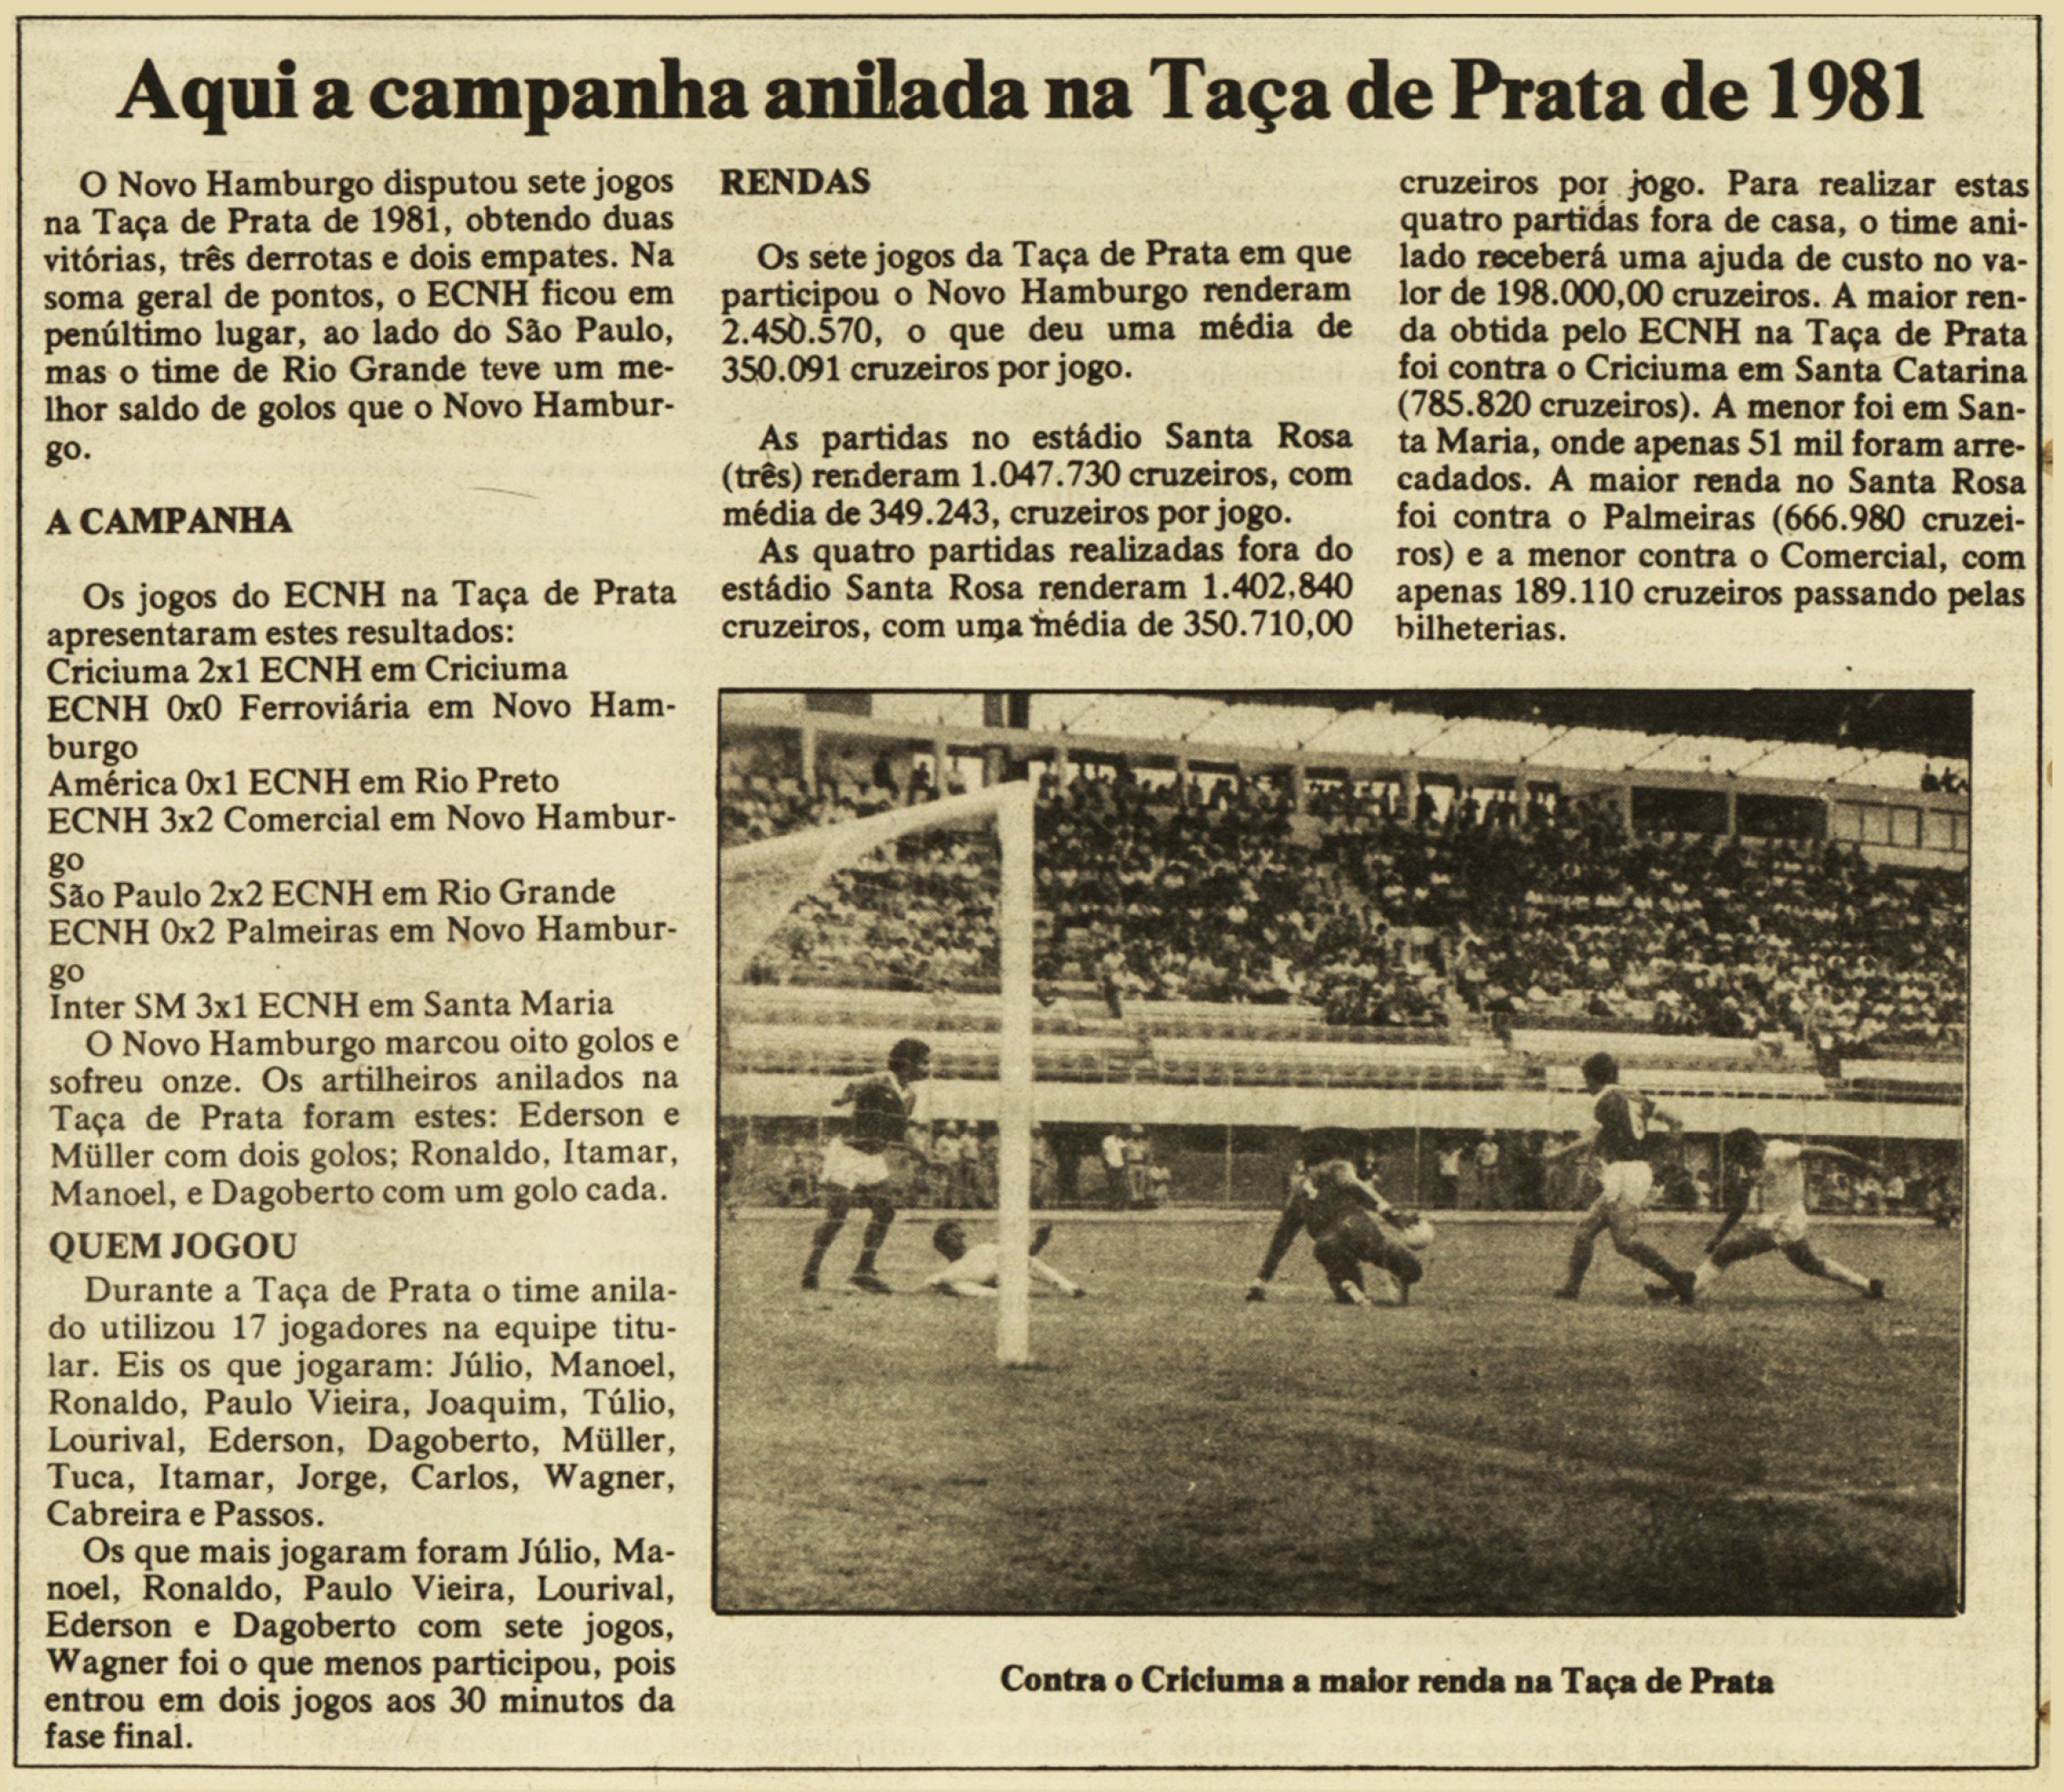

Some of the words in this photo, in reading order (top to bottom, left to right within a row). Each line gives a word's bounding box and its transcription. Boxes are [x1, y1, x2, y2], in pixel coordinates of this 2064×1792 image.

[115, 58, 299, 136] Aqui
[312, 78, 354, 120] a
[368, 57, 749, 137] campanha
[764, 57, 1029, 120] anilada
[1043, 77, 1133, 120] na
[1149, 57, 1332, 134] Taça
[1346, 58, 1434, 120] de
[1450, 58, 1645, 122] Prata
[1660, 58, 1749, 121] de
[1768, 57, 1925, 122] 1981
[79, 170, 107, 198] O
[118, 170, 197, 198] Novo
[206, 169, 374, 204] Hamburgo
[383, 168, 518, 203] disputou
[528, 170, 586, 195] sete
[592, 167, 673, 202] jogos
[720, 167, 871, 196] RENDAS
[1399, 168, 1539, 195] cruzeiros
[1559, 175, 1609, 203] por
[1627, 168, 1705, 203] jogo.
[1727, 168, 1799, 196] Para
[1819, 169, 1937, 197] realizar
[1955, 174, 2030, 198] estas
[1399, 242, 1466, 270] lado
[1477, 241, 1608, 270] receberá
[1618, 250, 1687, 270] uma
[1698, 243, 1785, 278] ajuda
[1796, 243, 1831, 271] de
[1842, 247, 1924, 272] custo
[1933, 252, 1972, 273] no
[1982, 252, 2028, 273] va-
[44, 318, 202, 356] penúltimo
[215, 319, 306, 354] lugar,
[323, 325, 359, 345] ao
[372, 317, 440, 345] lado
[453, 317, 491, 345] do
[506, 316, 562, 344] São
[576, 315, 673, 346] Paulo,
[721, 317, 883, 347] 2.450.570,
[907, 324, 926, 344] o
[949, 323, 1005, 351] que
[1028, 314, 1084, 342] deu
[1107, 320, 1176, 341] uma
[1199, 311, 1295, 340] média
[1316, 311, 1353, 339] de
[721, 354, 840, 384] 350.091
[850, 353, 989, 381] cruzeiros
[997, 360, 1051, 387] por
[1055, 352, 1132, 387] jogo.
[1398, 389, 1532, 422] (785.820
[1539, 390, 1700, 423] cruzeiros).
[1712, 391, 1737, 419] A
[1746, 399, 1846, 421] menor
[1853, 391, 1894, 421] foi
[1903, 400, 1949, 421] em
[1958, 393, 2026, 421] San-
[721, 461, 803, 494] (três)
[812, 461, 960, 489] renderam
[972, 459, 1121, 488] 1.047.730
[1129, 459, 1278, 490] cruzeiros,
[1288, 466, 1353, 487] com
[44, 508, 72, 536] A
[79, 506, 293, 536] CAMPANHA
[722, 498, 817, 527] média
[825, 498, 861, 526] de
[869, 497, 1000, 530] 349.243,
[1009, 497, 1150, 525] cruzeiros
[1157, 504, 1211, 533] por
[1213, 496, 1292, 532] jogo.
[1397, 500, 1437, 530] foi
[1453, 504, 1552, 530] contra
[1568, 510, 1587, 530] o
[1603, 503, 1755, 531] Palmeiras
[1772, 503, 1905, 536] (666.980
[1922, 504, 2025, 533] cruzei-
[1396, 584, 1502, 612] apenas
[1515, 576, 1634, 605] 189.110
[1644, 578, 1783, 606] cruzeiros
[1794, 579, 1938, 613] passando
[1947, 579, 2026, 614] pelas
[47, 622, 257, 655] apresentaram
[265, 621, 338, 646] estes
[347, 617, 514, 646] resultados:
[1396, 613, 1566, 642] bilheterias.
[46, 657, 190, 686] Criciuma
[198, 656, 249, 684] 2x1
[260, 655, 362, 683] ECNH
[371, 663, 416, 683] em
[425, 653, 569, 682] Criciuma
[46, 733, 139, 767] burgo
[48, 806, 149, 834] ECNH
[160, 805, 213, 833] 3x2
[223, 804, 380, 833] Comercial
[390, 812, 435, 831] em
[447, 804, 525, 831] Novo
[537, 803, 676, 830] Hambur-
[51, 994, 126, 1020] Inter
[135, 992, 186, 1019] SM
[196, 992, 247, 1019] 3x1
[258, 991, 359, 1019] ECNH
[368, 998, 414, 1018] em
[424, 990, 511, 1017] Santa
[521, 988, 614, 1016] Maria
[51, 1180, 176, 1208] Manoel,
[188, 1187, 202, 1205] e
[212, 1178, 374, 1213] Dagoberto
[382, 1185, 445, 1204] com
[455, 1184, 504, 1203] um
[514, 1176, 578, 1210] golo
[586, 1175, 666, 1201] cada.
[49, 1231, 161, 1264] QUEM
[171, 1232, 297, 1260] JOGOU
[48, 1351, 99, 1378] lar.
[117, 1351, 164, 1378] Eis
[180, 1358, 211, 1378] os
[227, 1358, 282, 1385] que
[294, 1351, 432, 1385] jogaram:
[449, 1351, 532, 1381] Júlio,
[550, 1351, 675, 1380] Manoel,
[48, 1426, 185, 1455] Lourival,
[208, 1426, 344, 1456] Ederson,
[367, 1426, 539, 1460] Dagoberto,
[563, 1426, 675, 1456] Müller,
[46, 1462, 135, 1493] Tuca,
[160, 1463, 274, 1494] Itamar,
[296, 1463, 387, 1497] Jorge,
[411, 1463, 519, 1494] Carlos,
[543, 1463, 674, 1497] Wagner,
[46, 1647, 169, 1683] Wagner
[179, 1647, 219, 1676] foi
[229, 1656, 248, 1676] o
[258, 1656, 314, 1684] que
[324, 1656, 422, 1676] menos
[433, 1648, 601, 1684] participou,
[614, 1648, 676, 1684] pois
[1001, 1664, 1107, 1693] Contra
[1115, 1673, 1133, 1693] o
[1141, 1665, 1285, 1693] Criciuma
[1292, 1674, 1311, 1693] a
[1319, 1666, 1410, 1693] maior
[1418, 1666, 1507, 1694] renda
[1514, 1674, 1554, 1694] na
[1561, 1666, 1637, 1700] Taça
[1645, 1666, 1682, 1694] de
[1690, 1666, 1775, 1694] Prata
[44, 1721, 106, 1749] fase
[113, 1720, 193, 1749] final.
